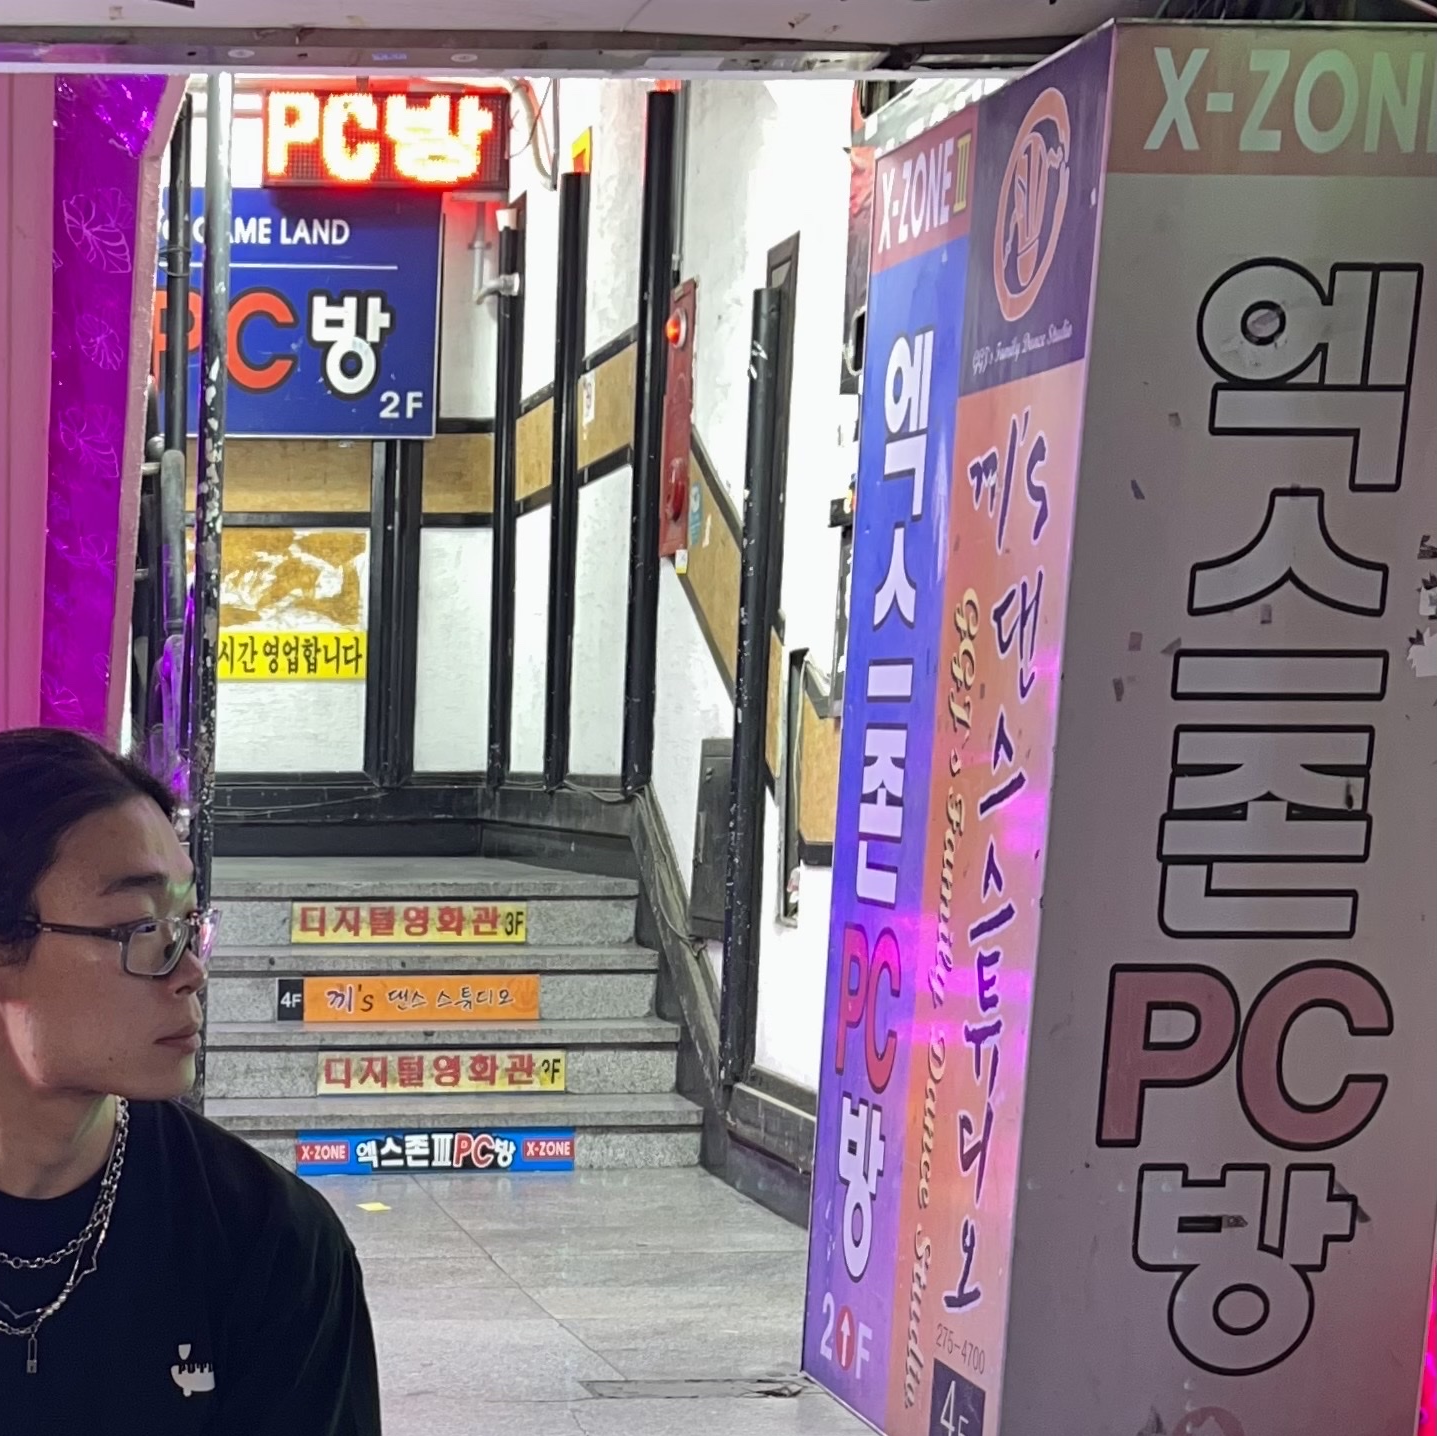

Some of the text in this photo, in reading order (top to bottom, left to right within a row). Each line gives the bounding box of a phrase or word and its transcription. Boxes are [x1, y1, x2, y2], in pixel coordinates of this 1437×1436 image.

[1143, 46, 1437, 153] X-ZON
[267, 91, 492, 183] PC방
[878, 137, 954, 253] X-ZONE
[280, 216, 351, 245] LAND
[379, 391, 423, 418] 2F
[263, 636, 363, 674] 영업합니다
[299, 906, 524, 937] 디지털영화관 3F
[280, 992, 302, 1008] 4F
[323, 1054, 535, 1088] 디지털영화관
[917, 1020, 946, 1210] Dance
[300, 1143, 347, 1161] X-ZONE
[525, 1139, 571, 1157] X-ZONE
[903, 1222, 933, 1409] Studio
